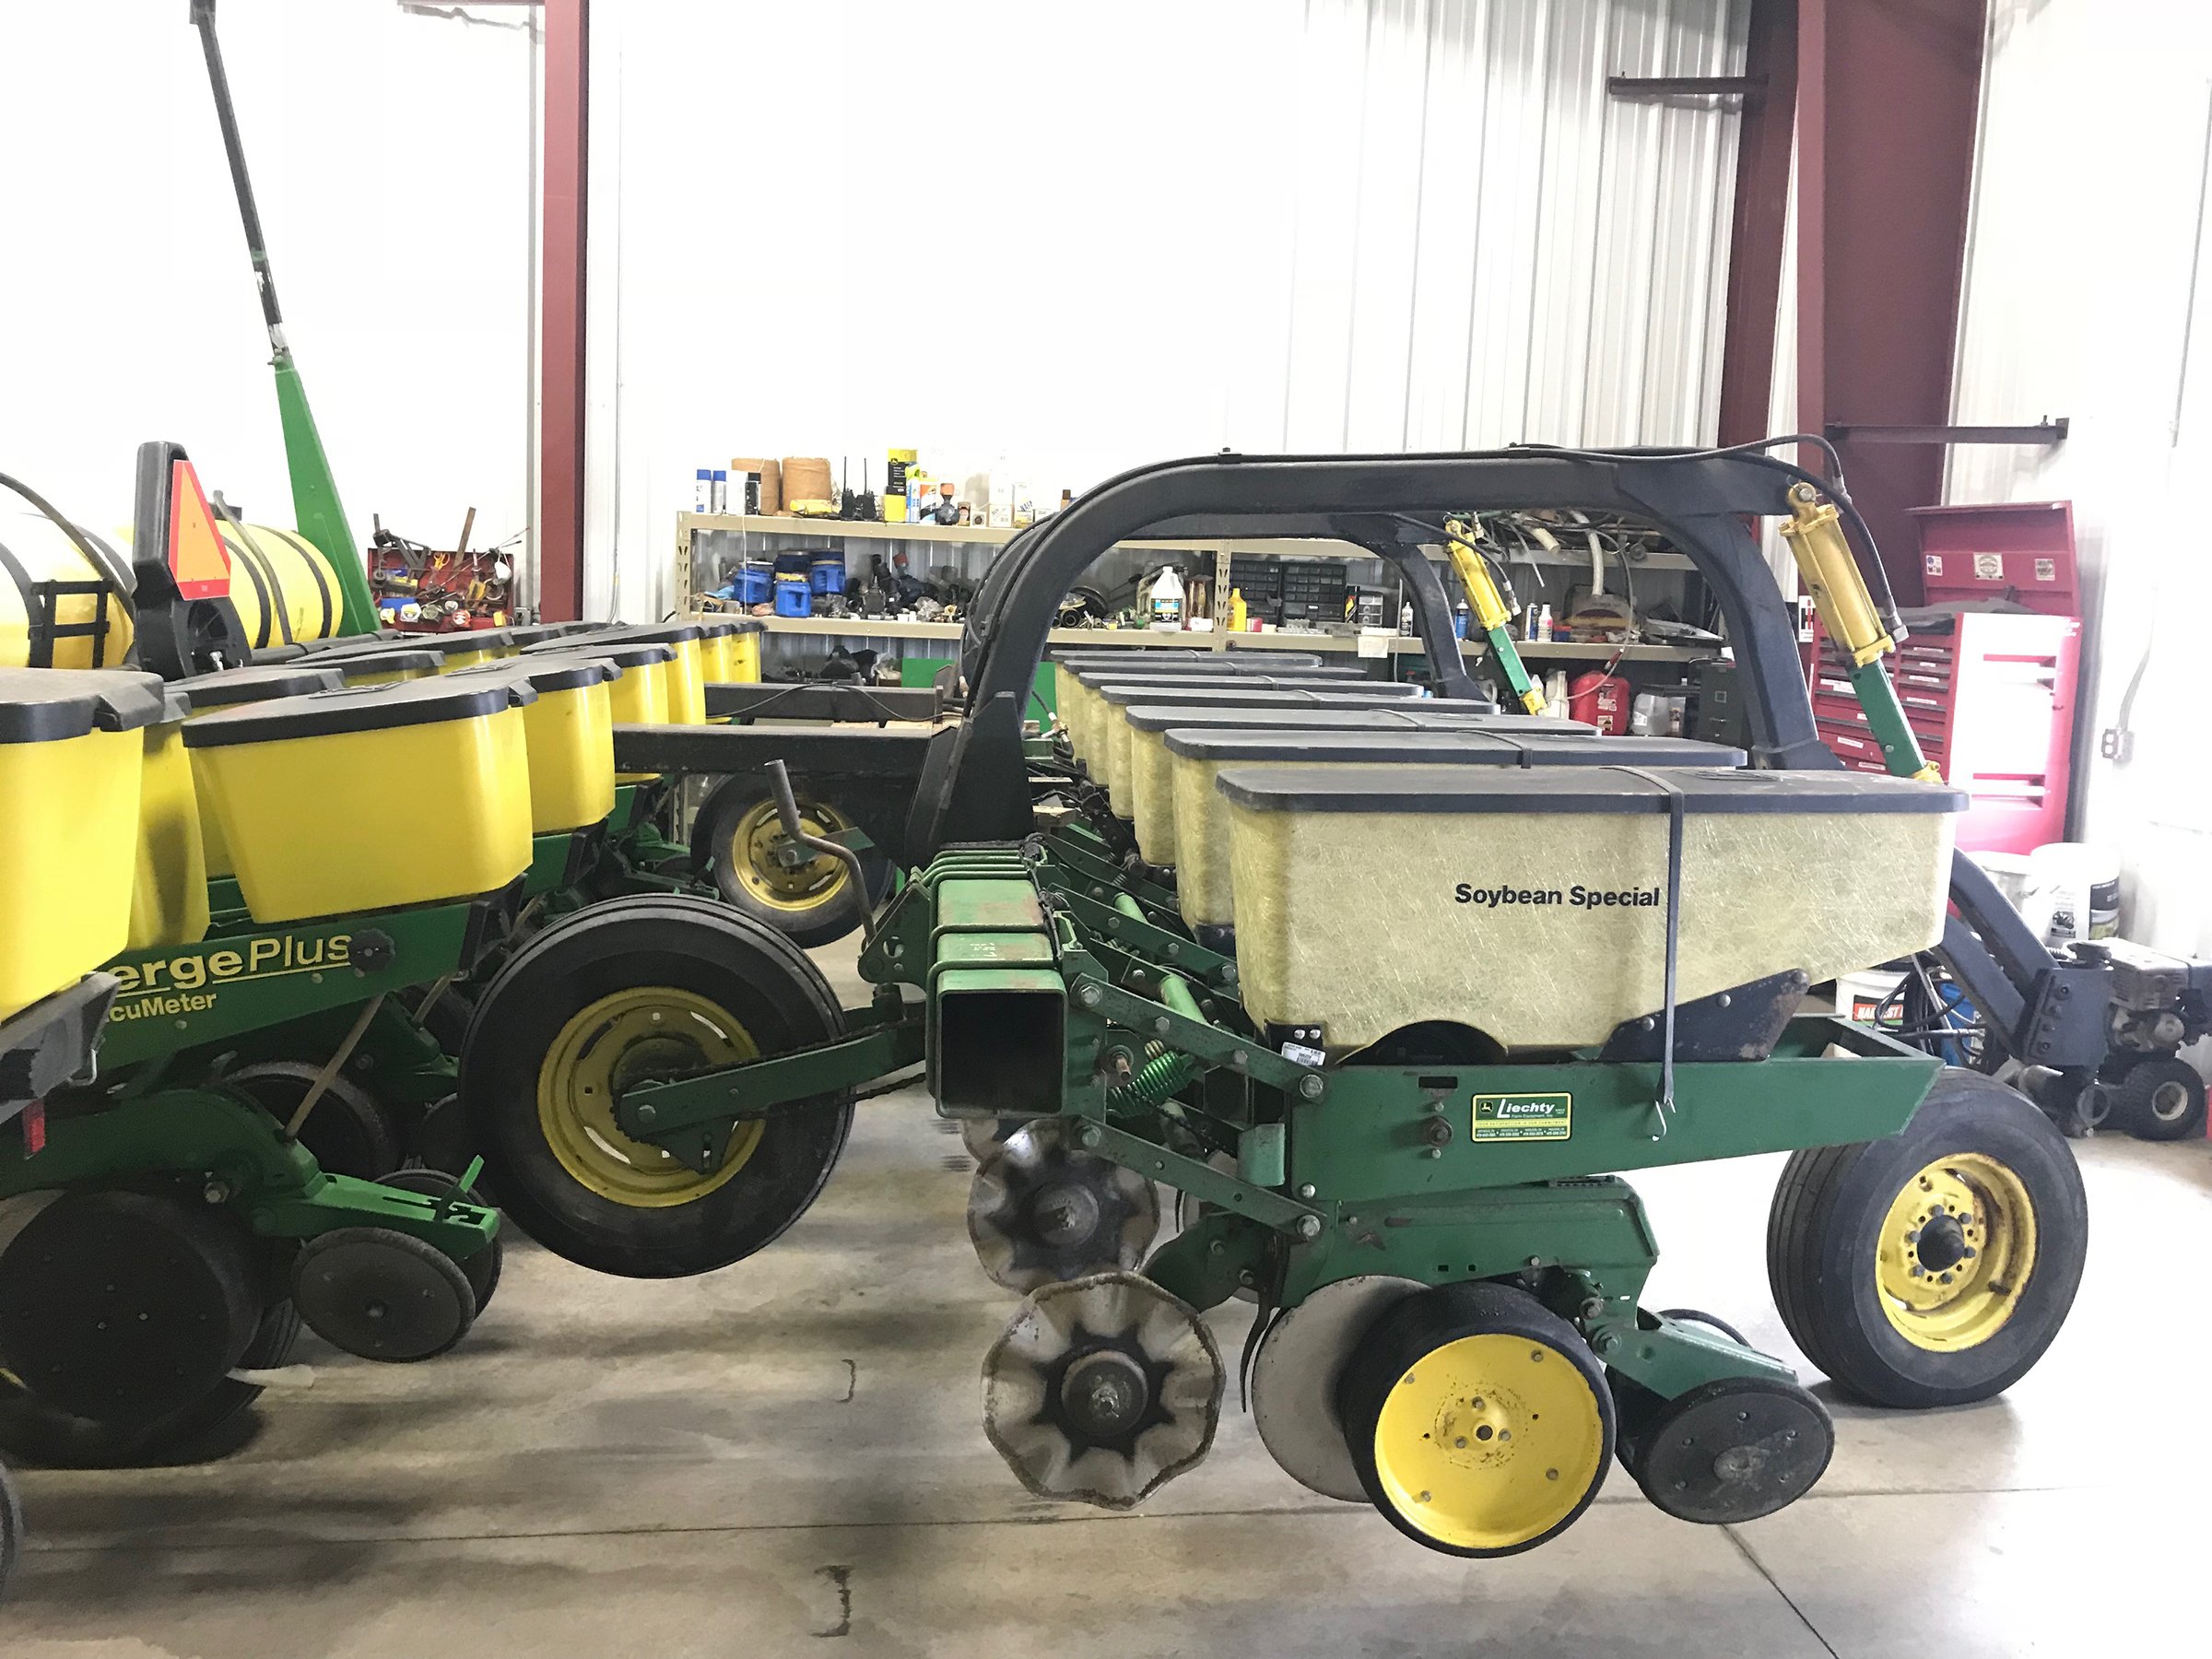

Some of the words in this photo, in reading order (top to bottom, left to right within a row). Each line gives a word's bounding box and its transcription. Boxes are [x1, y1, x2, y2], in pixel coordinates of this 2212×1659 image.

[1454, 883, 1562, 907] Soybean
[1569, 885, 1660, 910] Special
[105, 993, 217, 1022] cuMeter
[1497, 1099, 1555, 1118] Liechty
